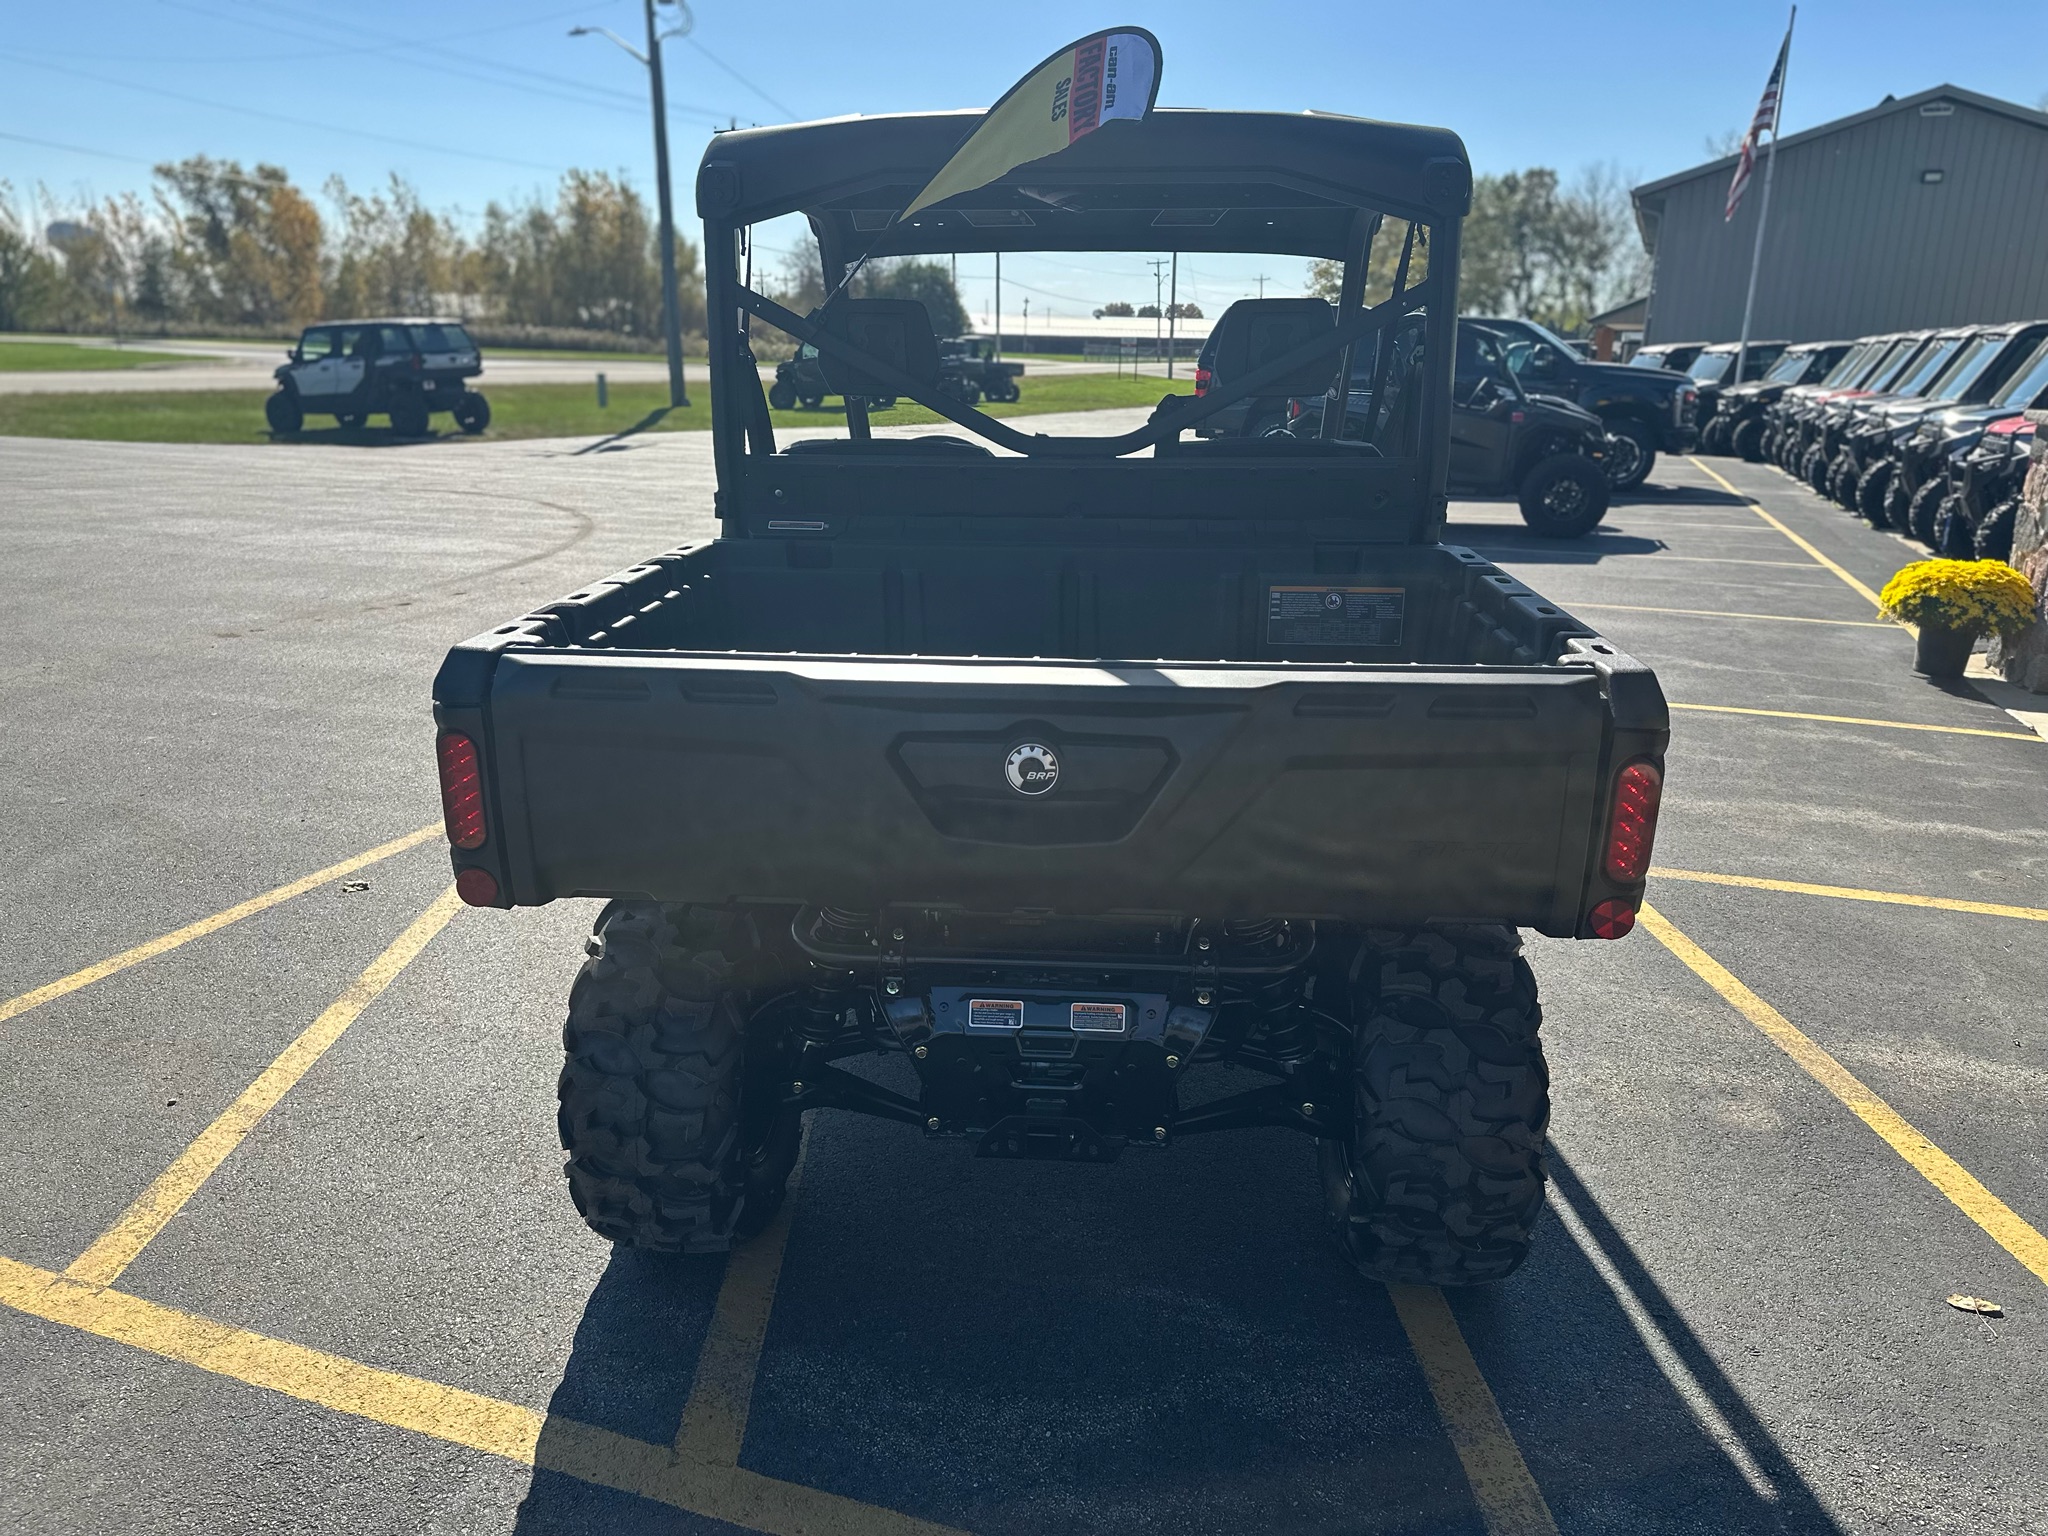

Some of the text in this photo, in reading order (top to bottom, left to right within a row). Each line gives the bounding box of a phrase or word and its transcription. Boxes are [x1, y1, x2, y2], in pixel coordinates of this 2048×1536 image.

[1051, 77, 1072, 122] SALES
[1073, 41, 1103, 134] FACTORY
[1104, 45, 1118, 111] can-am
[1026, 771, 1056, 780] BRP
